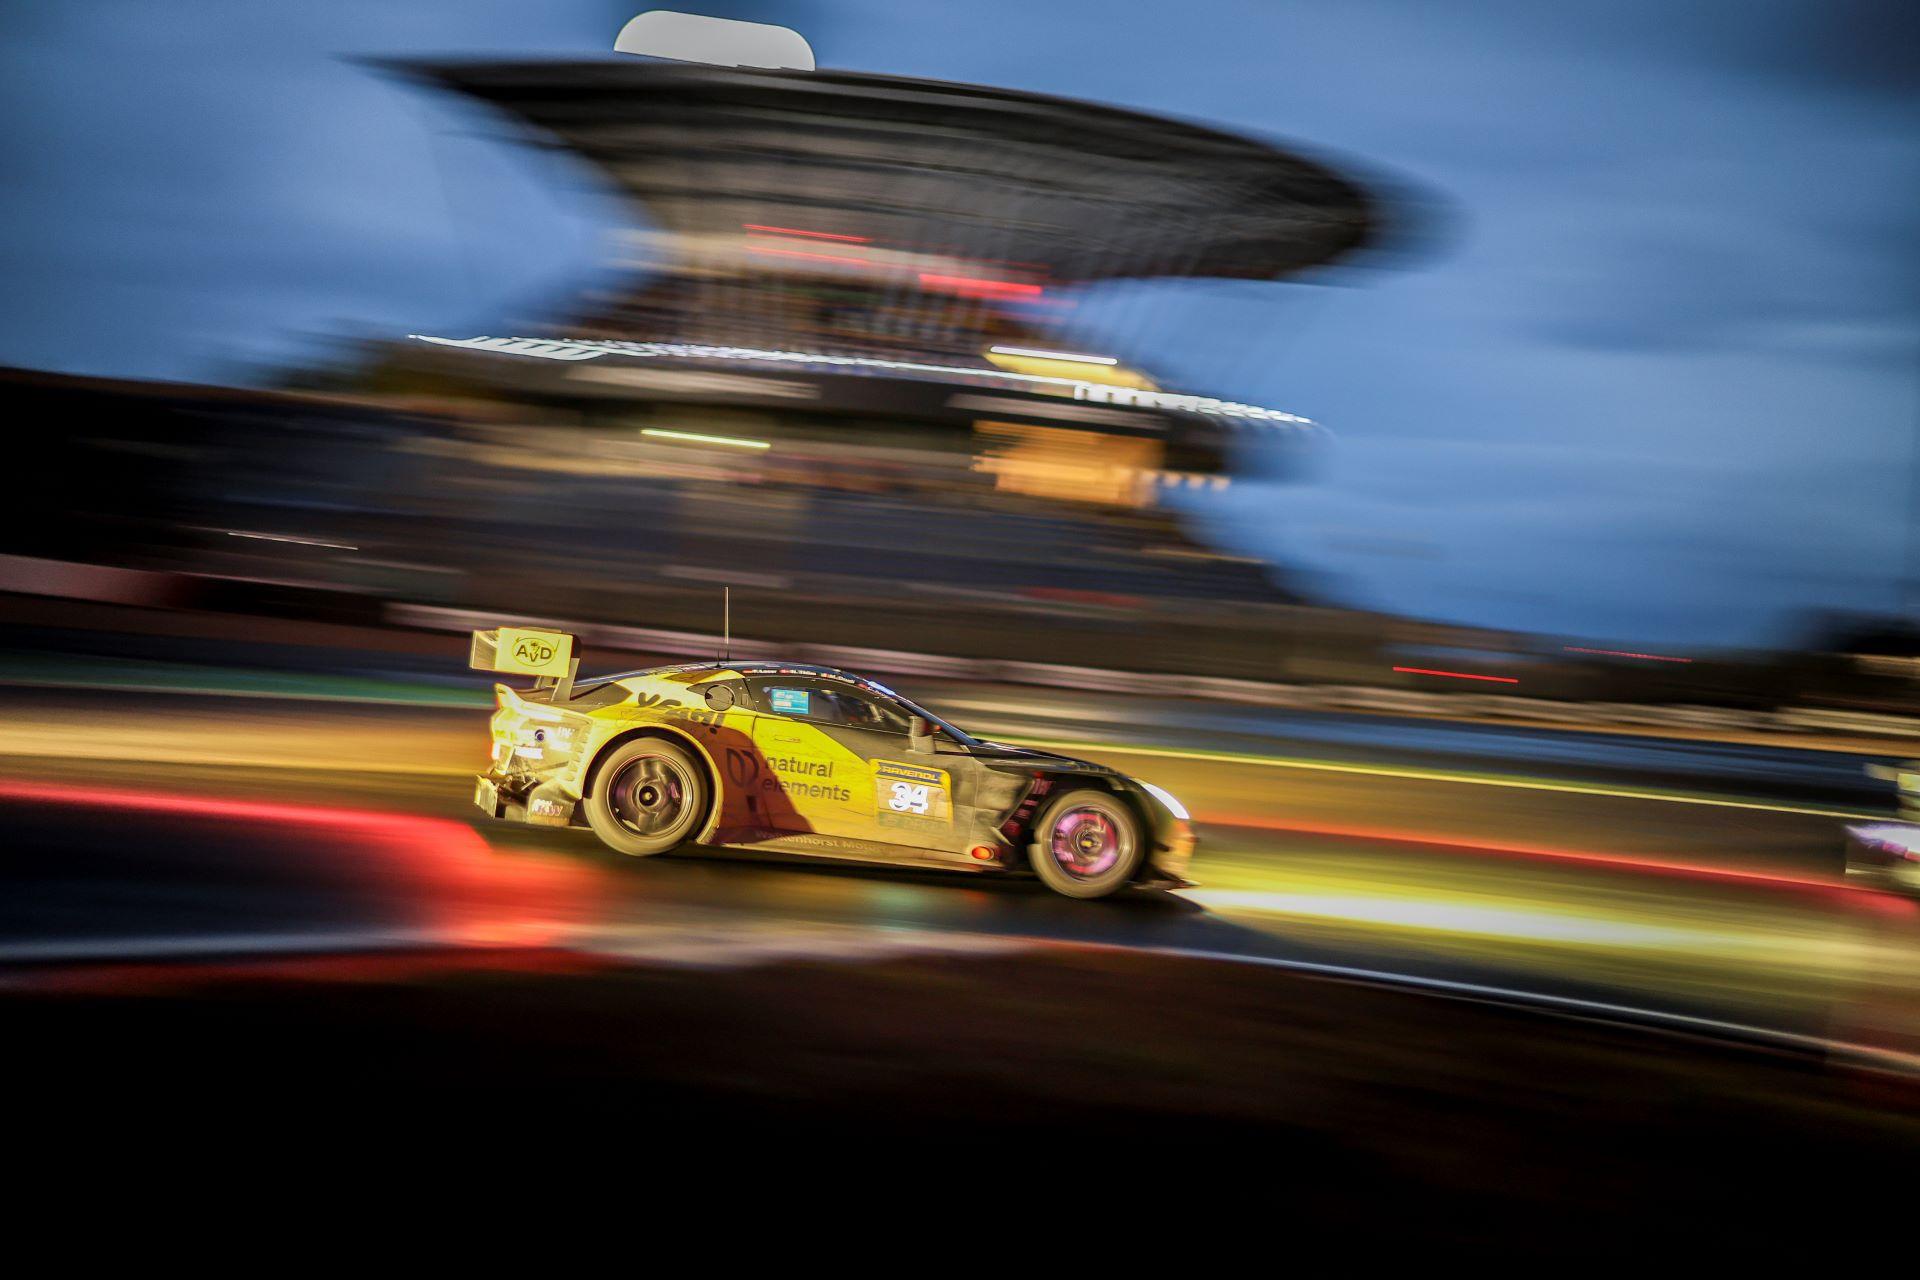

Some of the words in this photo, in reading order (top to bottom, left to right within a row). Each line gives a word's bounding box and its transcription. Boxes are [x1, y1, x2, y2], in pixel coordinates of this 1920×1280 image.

[765, 755, 834, 778] natural
[881, 764, 939, 782] RAVENOL
[762, 778, 851, 802] elements
[888, 782, 929, 815] 34
